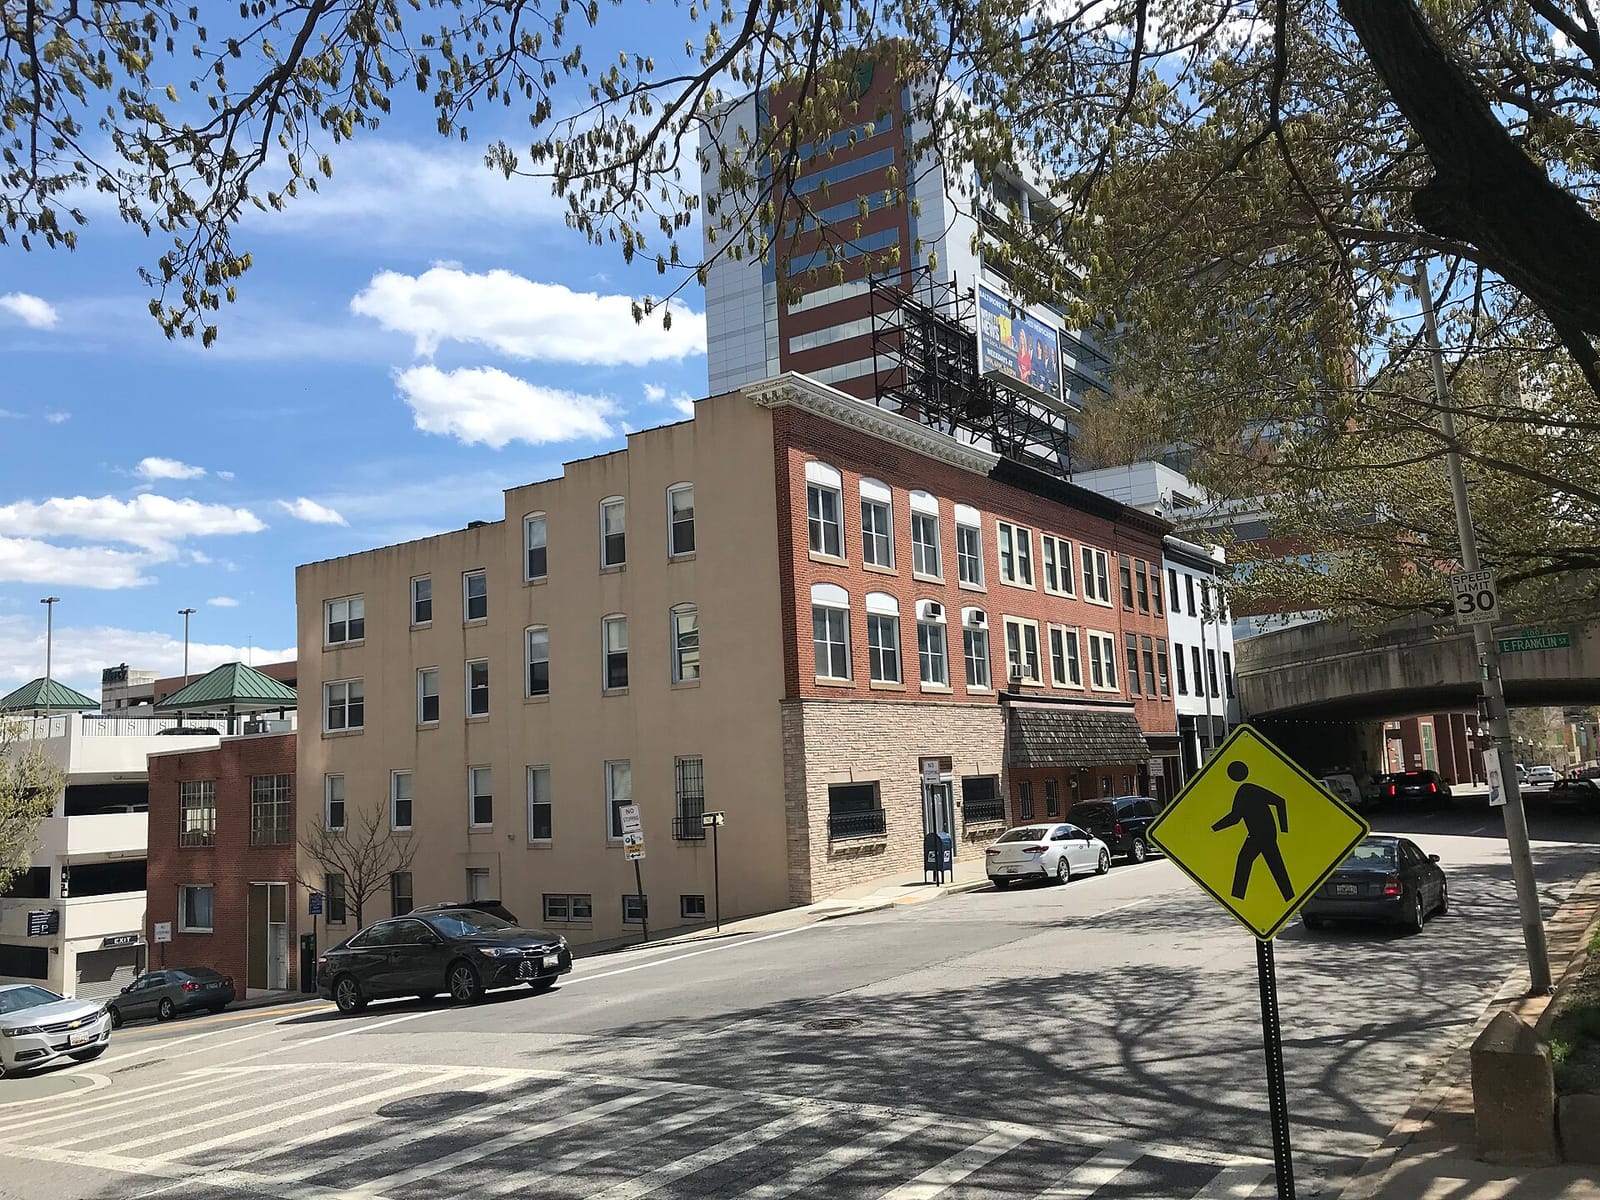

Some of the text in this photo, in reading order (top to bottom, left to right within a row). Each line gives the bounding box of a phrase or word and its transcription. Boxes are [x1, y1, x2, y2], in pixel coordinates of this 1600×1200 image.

[1452, 571, 1491, 585] SPEED
[1456, 581, 1490, 593] LIMIT
[1456, 590, 1495, 614] 30
[1503, 641, 1510, 651] E
[1511, 636, 1557, 651] FRANKLIN
[114, 936, 132, 944] EXIT
